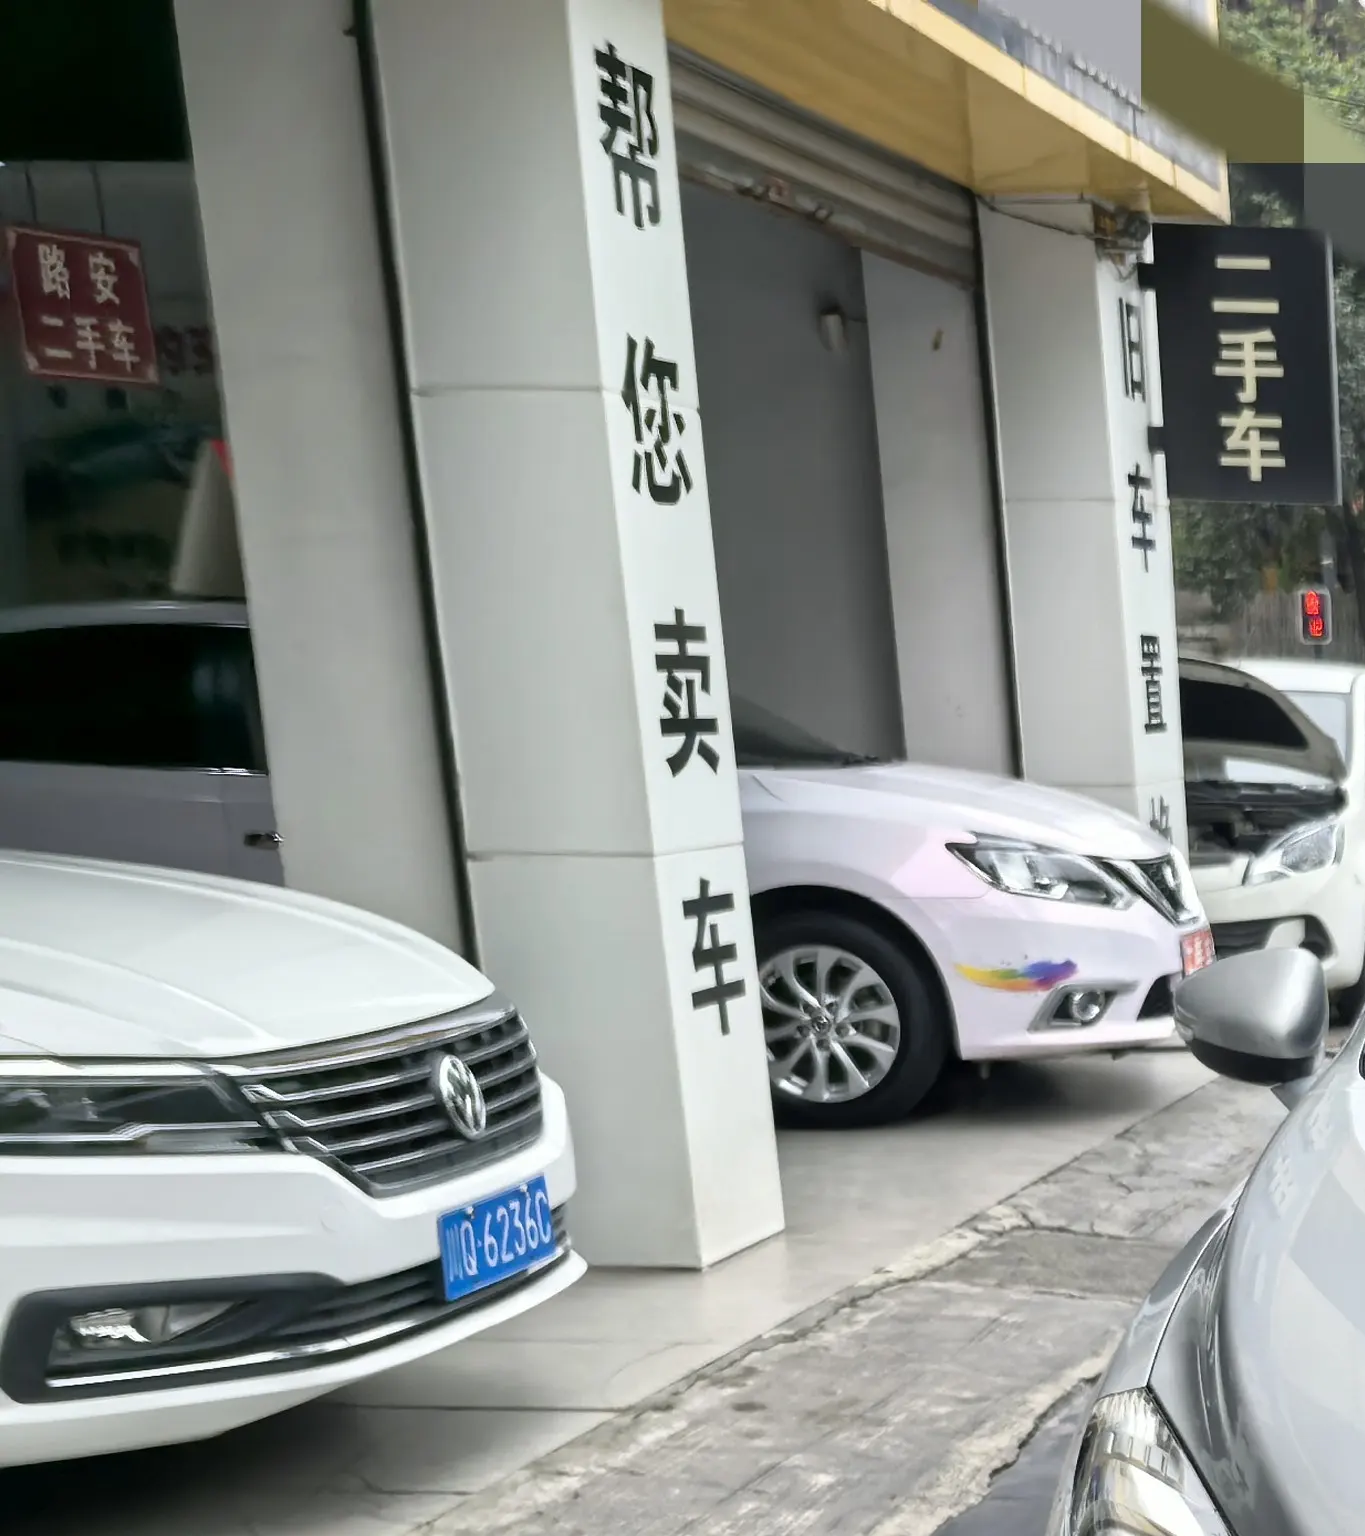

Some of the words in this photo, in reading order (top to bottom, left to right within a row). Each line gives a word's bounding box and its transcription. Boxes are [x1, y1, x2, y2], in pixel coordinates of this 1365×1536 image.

[41, 314, 141, 373] 二手车
[1211, 255, 1287, 482] 二手车
[593, 41, 747, 1036] 帮您卖车
